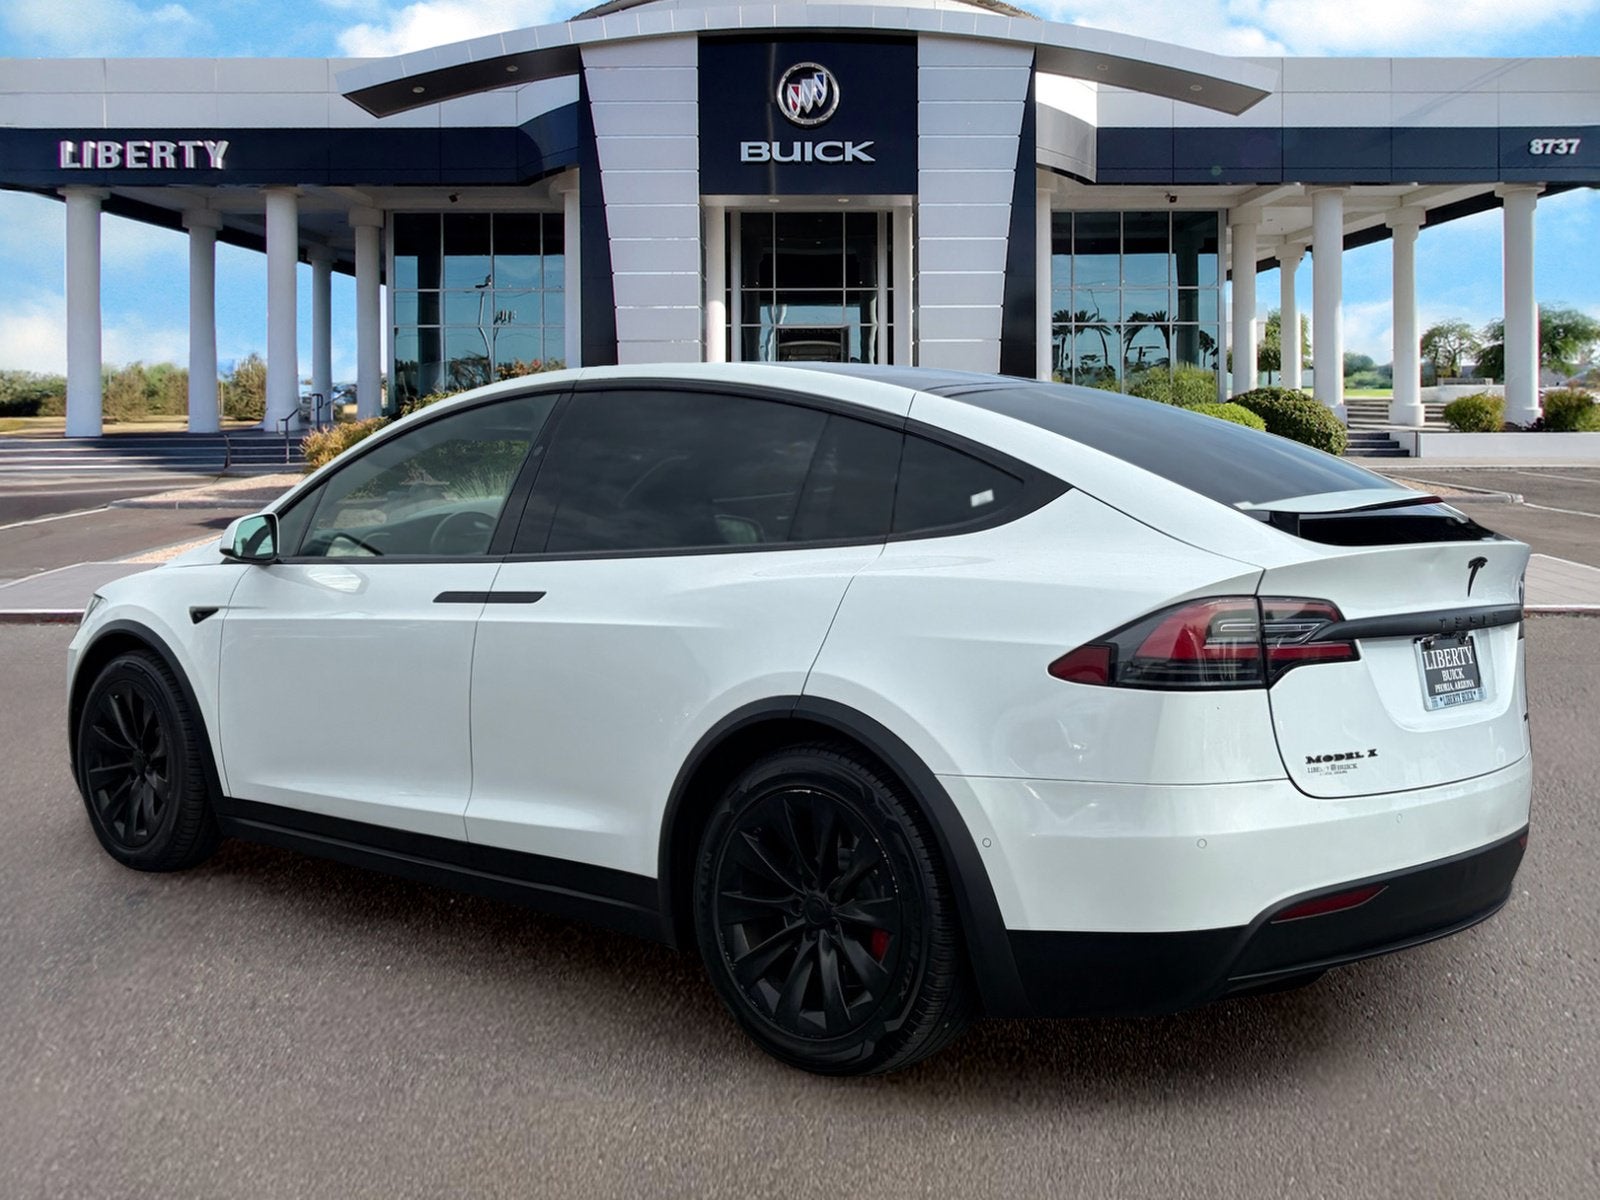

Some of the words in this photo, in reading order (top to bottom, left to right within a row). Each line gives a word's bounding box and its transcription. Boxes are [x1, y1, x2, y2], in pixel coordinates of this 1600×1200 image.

[59, 140, 229, 169] LIBERTY
[740, 141, 876, 162] BUICK
[1530, 138, 1581, 155] 8737
[1423, 645, 1474, 670] LIBERTY
[1441, 668, 1465, 681] BUICK
[1305, 751, 1364, 764] MODEL
[1367, 748, 1378, 757] X
